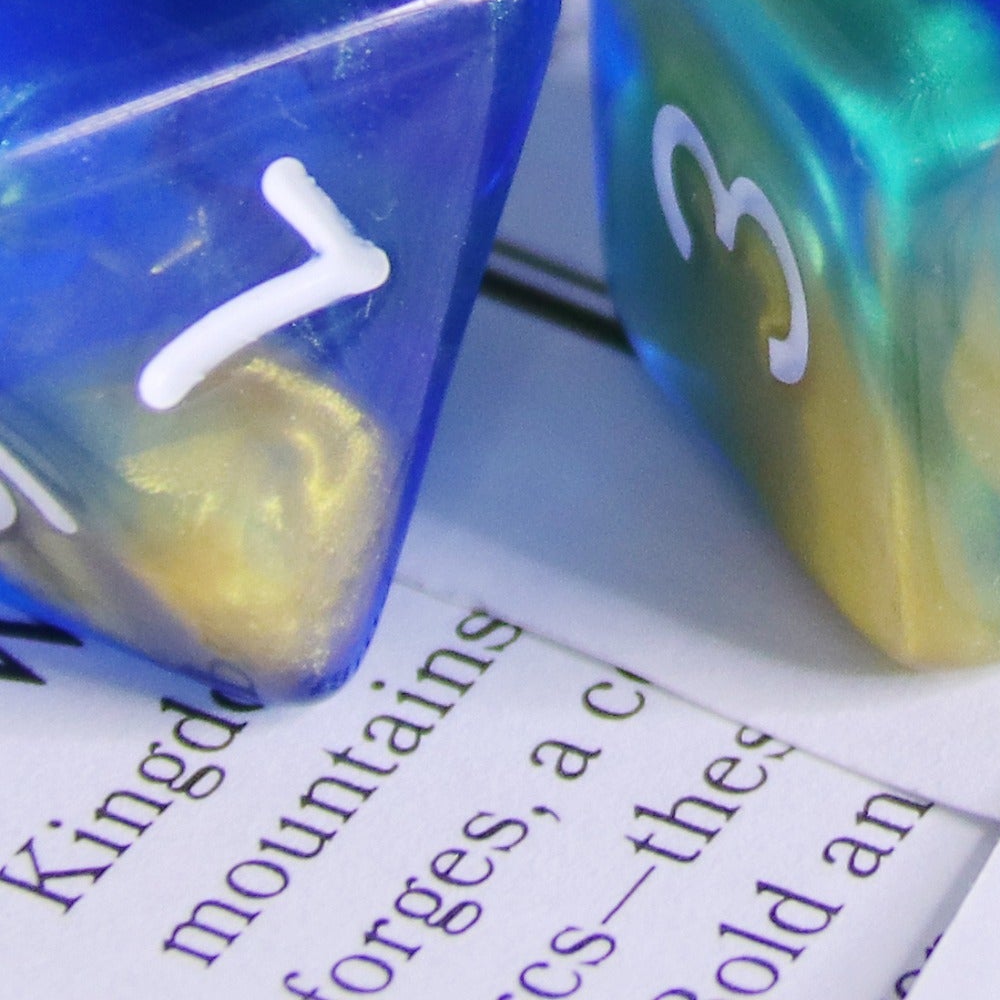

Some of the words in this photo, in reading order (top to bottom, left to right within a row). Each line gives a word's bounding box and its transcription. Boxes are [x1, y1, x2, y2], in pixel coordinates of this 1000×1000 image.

[652, 103, 810, 385] 3
[163, 605, 524, 968] mountains
[530, 738, 603, 782] a
[653, 879, 845, 1000] old
